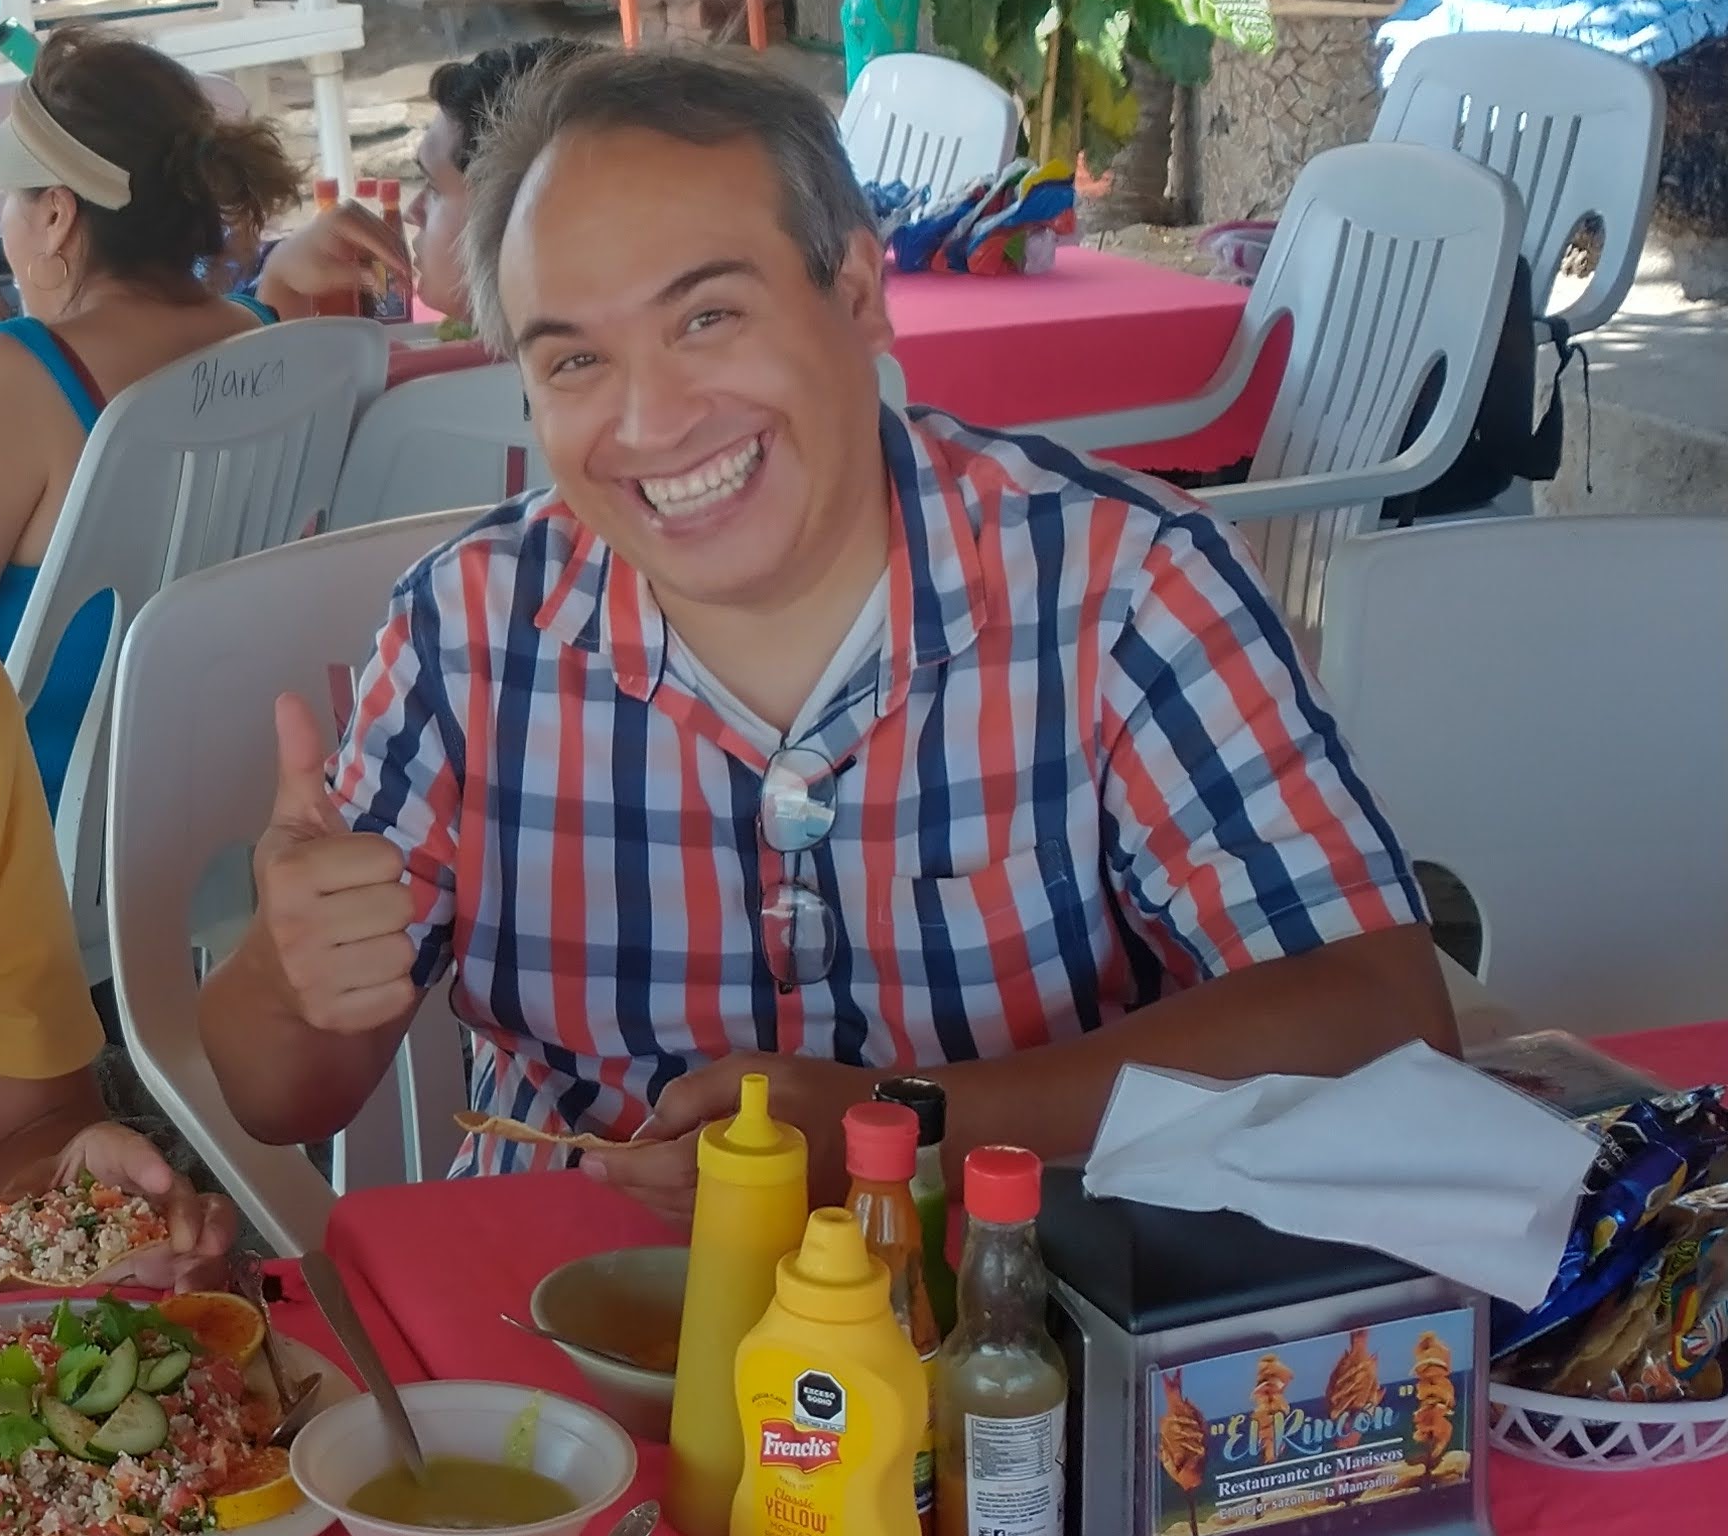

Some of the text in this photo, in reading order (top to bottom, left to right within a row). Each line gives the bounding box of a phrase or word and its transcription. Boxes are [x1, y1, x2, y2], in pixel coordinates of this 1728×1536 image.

[803, 1386, 836, 1400] EXCESO
[806, 1394, 833, 1407] SODIO
[763, 1430, 833, 1458] French's
[1218, 1447, 1404, 1498] Restaurante de Mariscos
[774, 1487, 816, 1511] Classic
[1233, 1500, 1269, 1516] mejor
[1308, 1486, 1322, 1502] de
[1324, 1486, 1336, 1499] la
[1338, 1473, 1399, 1497] Manzanilla
[765, 1495, 828, 1534] YELLOW
